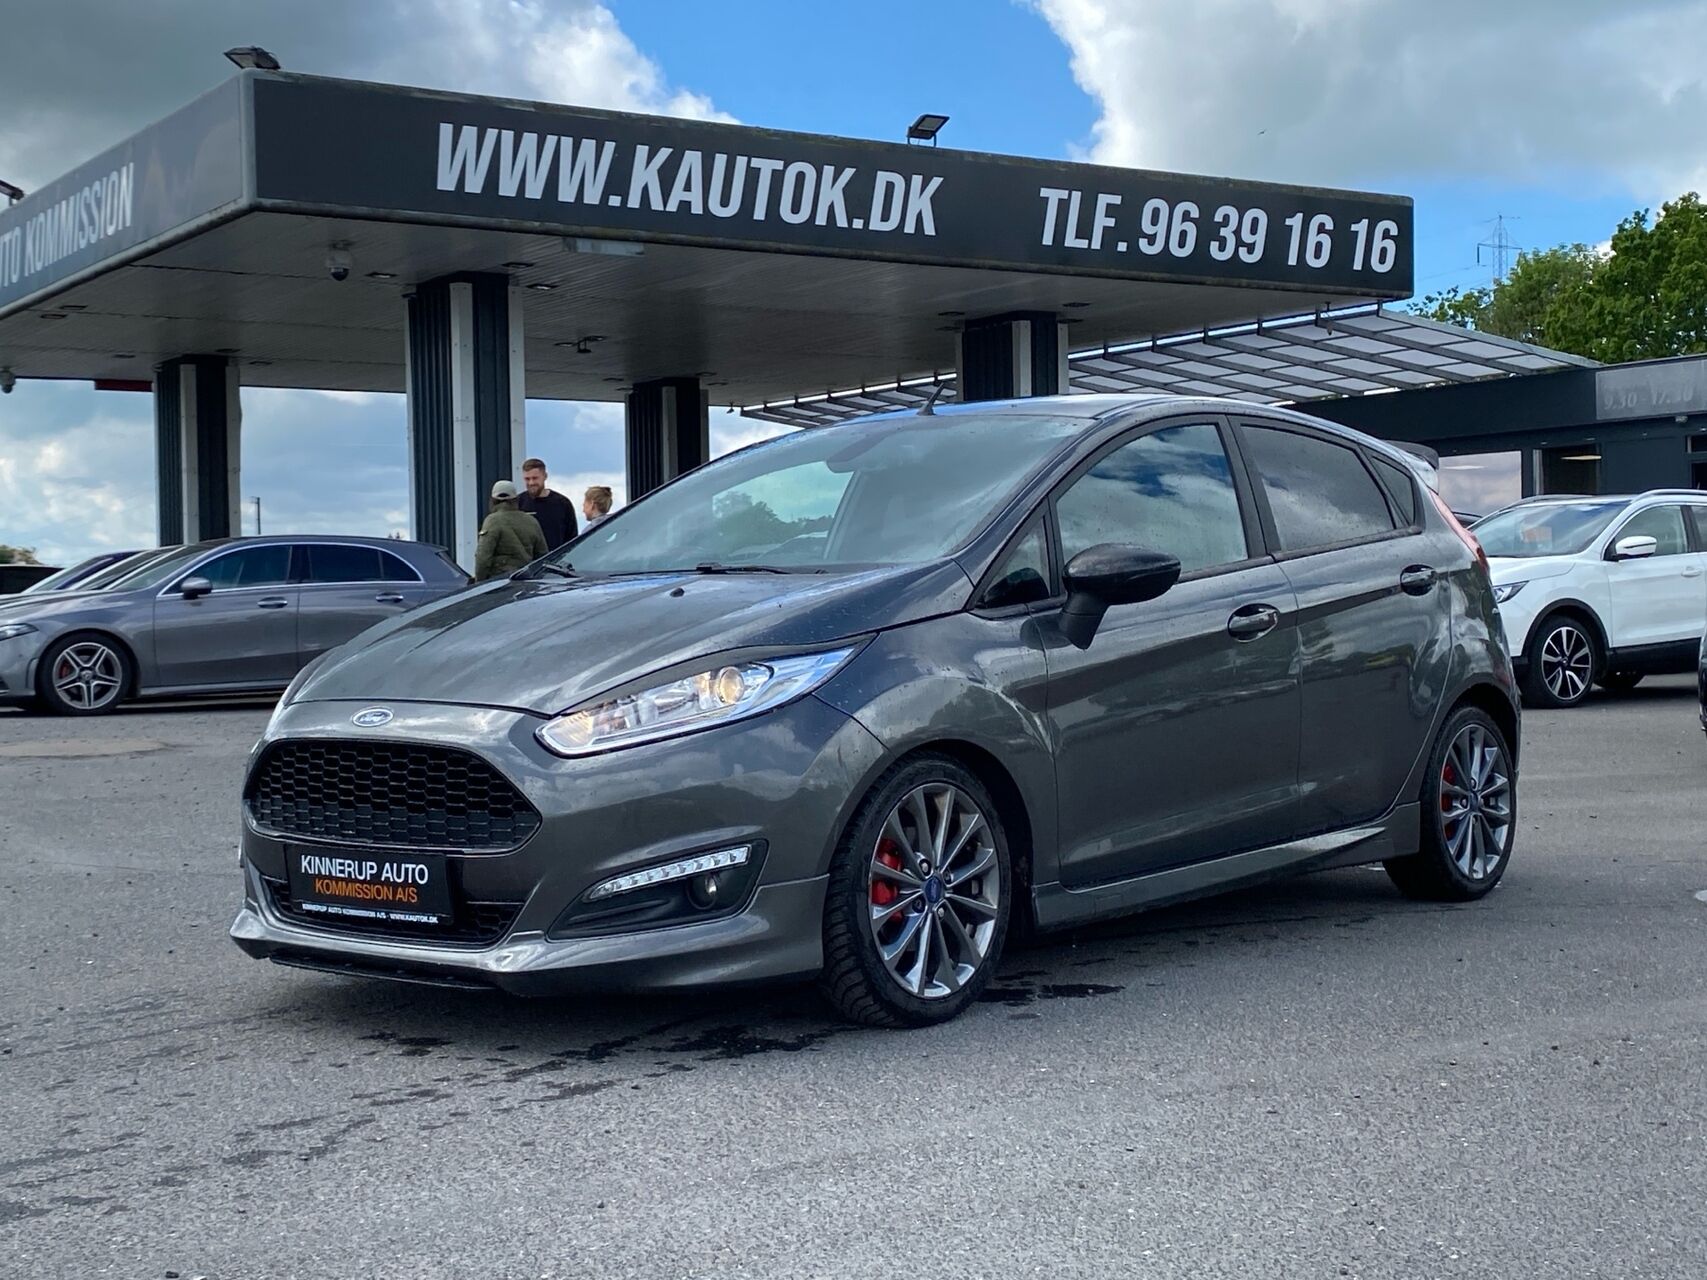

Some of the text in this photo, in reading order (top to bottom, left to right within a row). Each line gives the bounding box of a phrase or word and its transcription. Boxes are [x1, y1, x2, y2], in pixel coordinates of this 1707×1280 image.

[24, 162, 134, 277] KOMMISSION
[436, 122, 944, 237] WWW.KAUTOK.DK
[1039, 187, 1399, 273] TLF. 96 39 16 16
[301, 854, 429, 885] KINNERUP AUTO
[314, 878, 418, 903] KOMMISSION A/S
